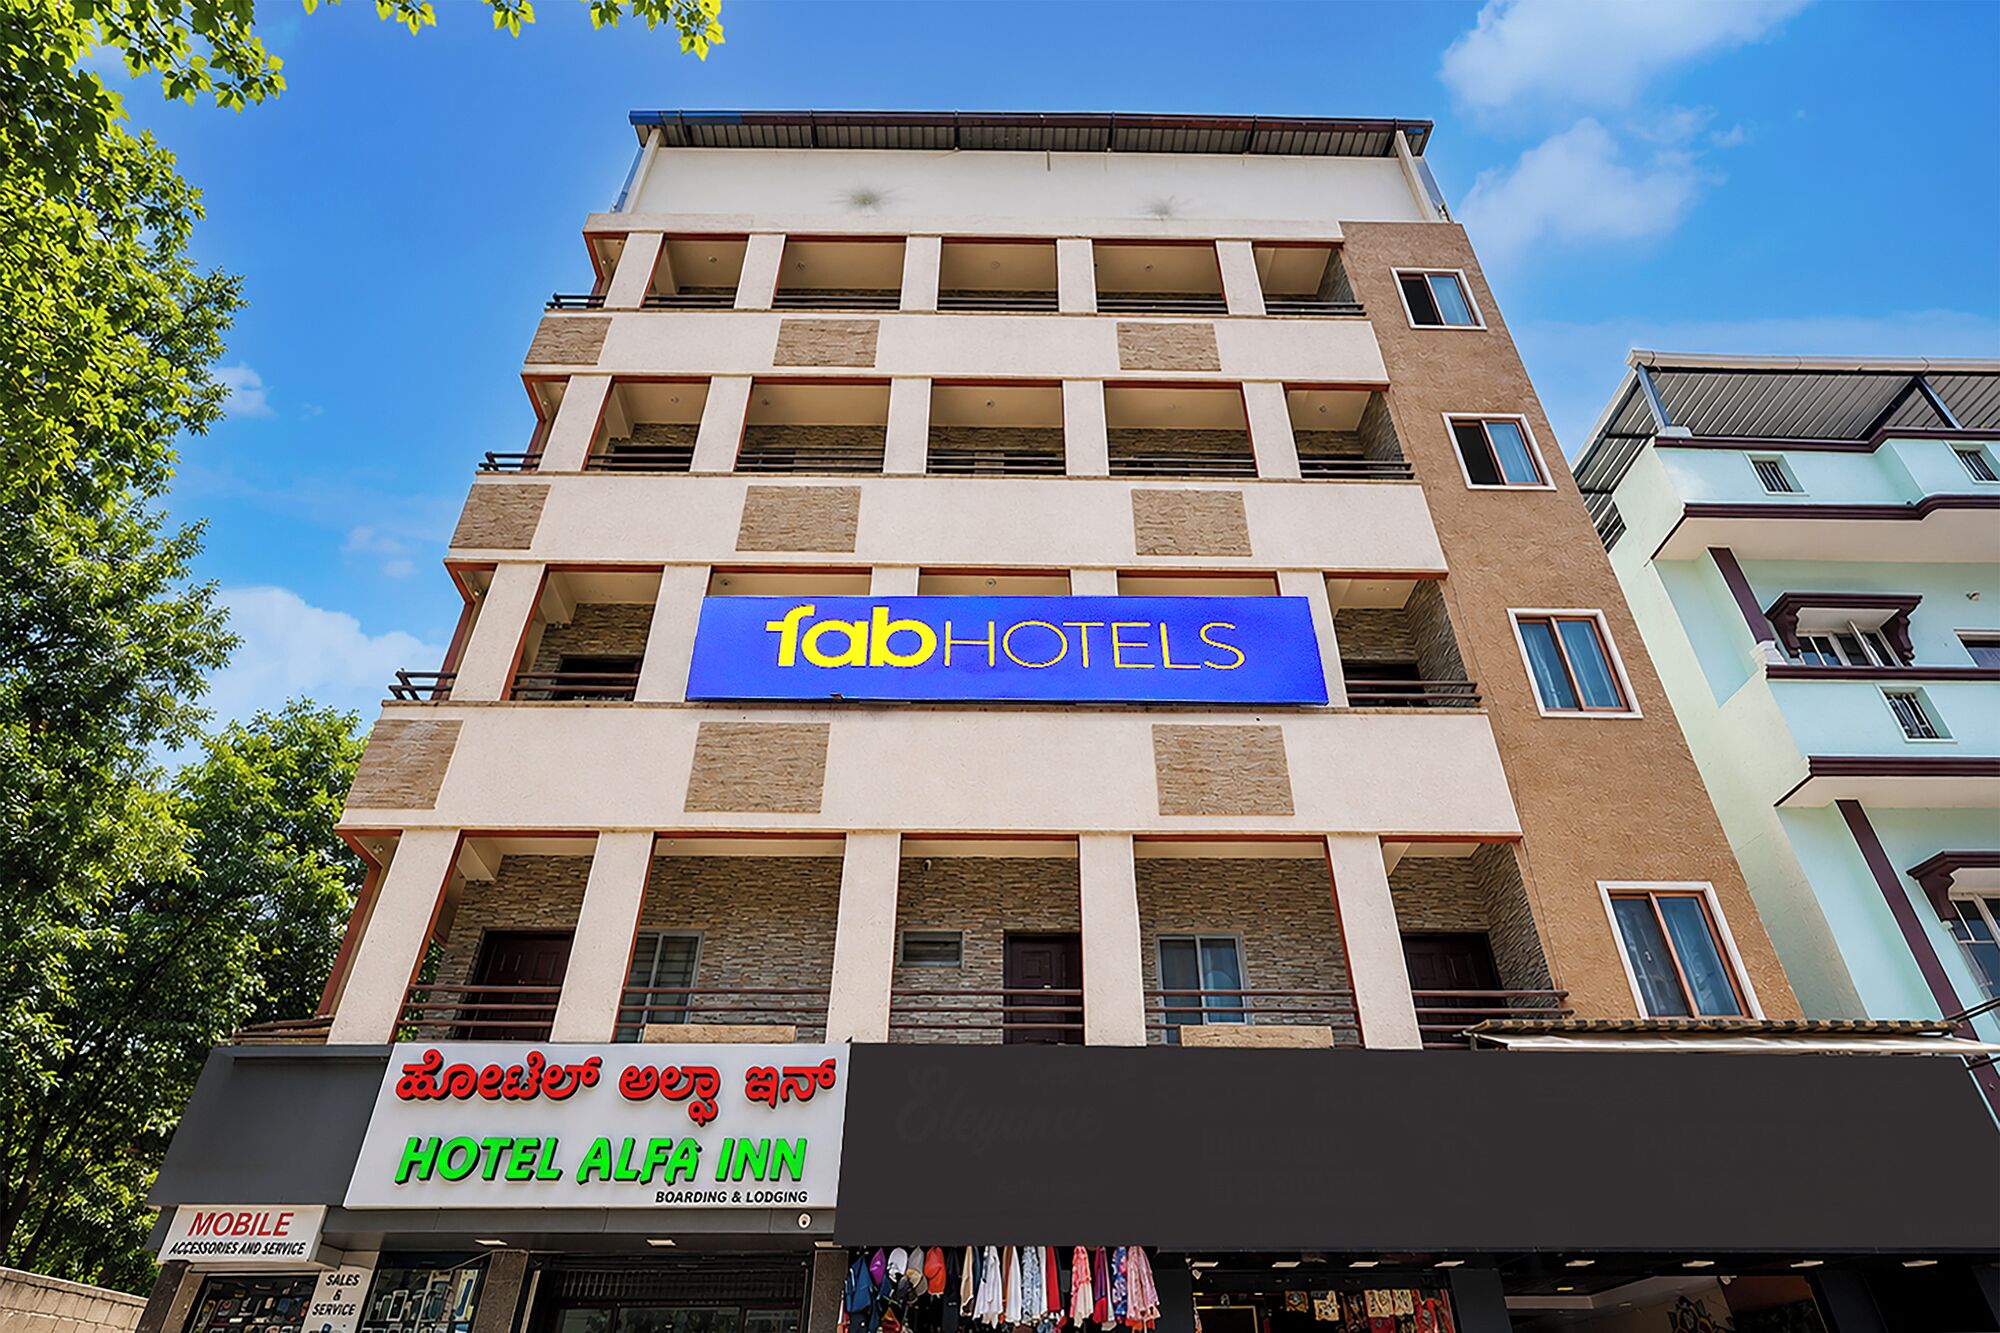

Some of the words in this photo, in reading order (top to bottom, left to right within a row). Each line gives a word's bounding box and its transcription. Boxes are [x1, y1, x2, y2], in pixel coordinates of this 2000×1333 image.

[395, 1048, 603, 1101] ಹೋಟೆಲ್
[618, 1065, 721, 1127] ಅಲ್ಫಾ
[744, 1058, 837, 1109] ಇನ್
[394, 1136, 564, 1185] HOTEL
[576, 1137, 702, 1186] ALFA
[715, 1137, 808, 1182] INN
[655, 1191, 728, 1204] BOARDING
[731, 1191, 742, 1204] &
[745, 1191, 808, 1204] LODGING
[187, 1212, 295, 1237] MOBILE
[168, 1241, 239, 1255] ACCESSORIES
[239, 1241, 261, 1255] AND
[261, 1241, 306, 1256] SERVICE
[325, 1273, 361, 1287] SALES
[332, 1289, 342, 1301] &
[311, 1303, 357, 1317] SERVICE
